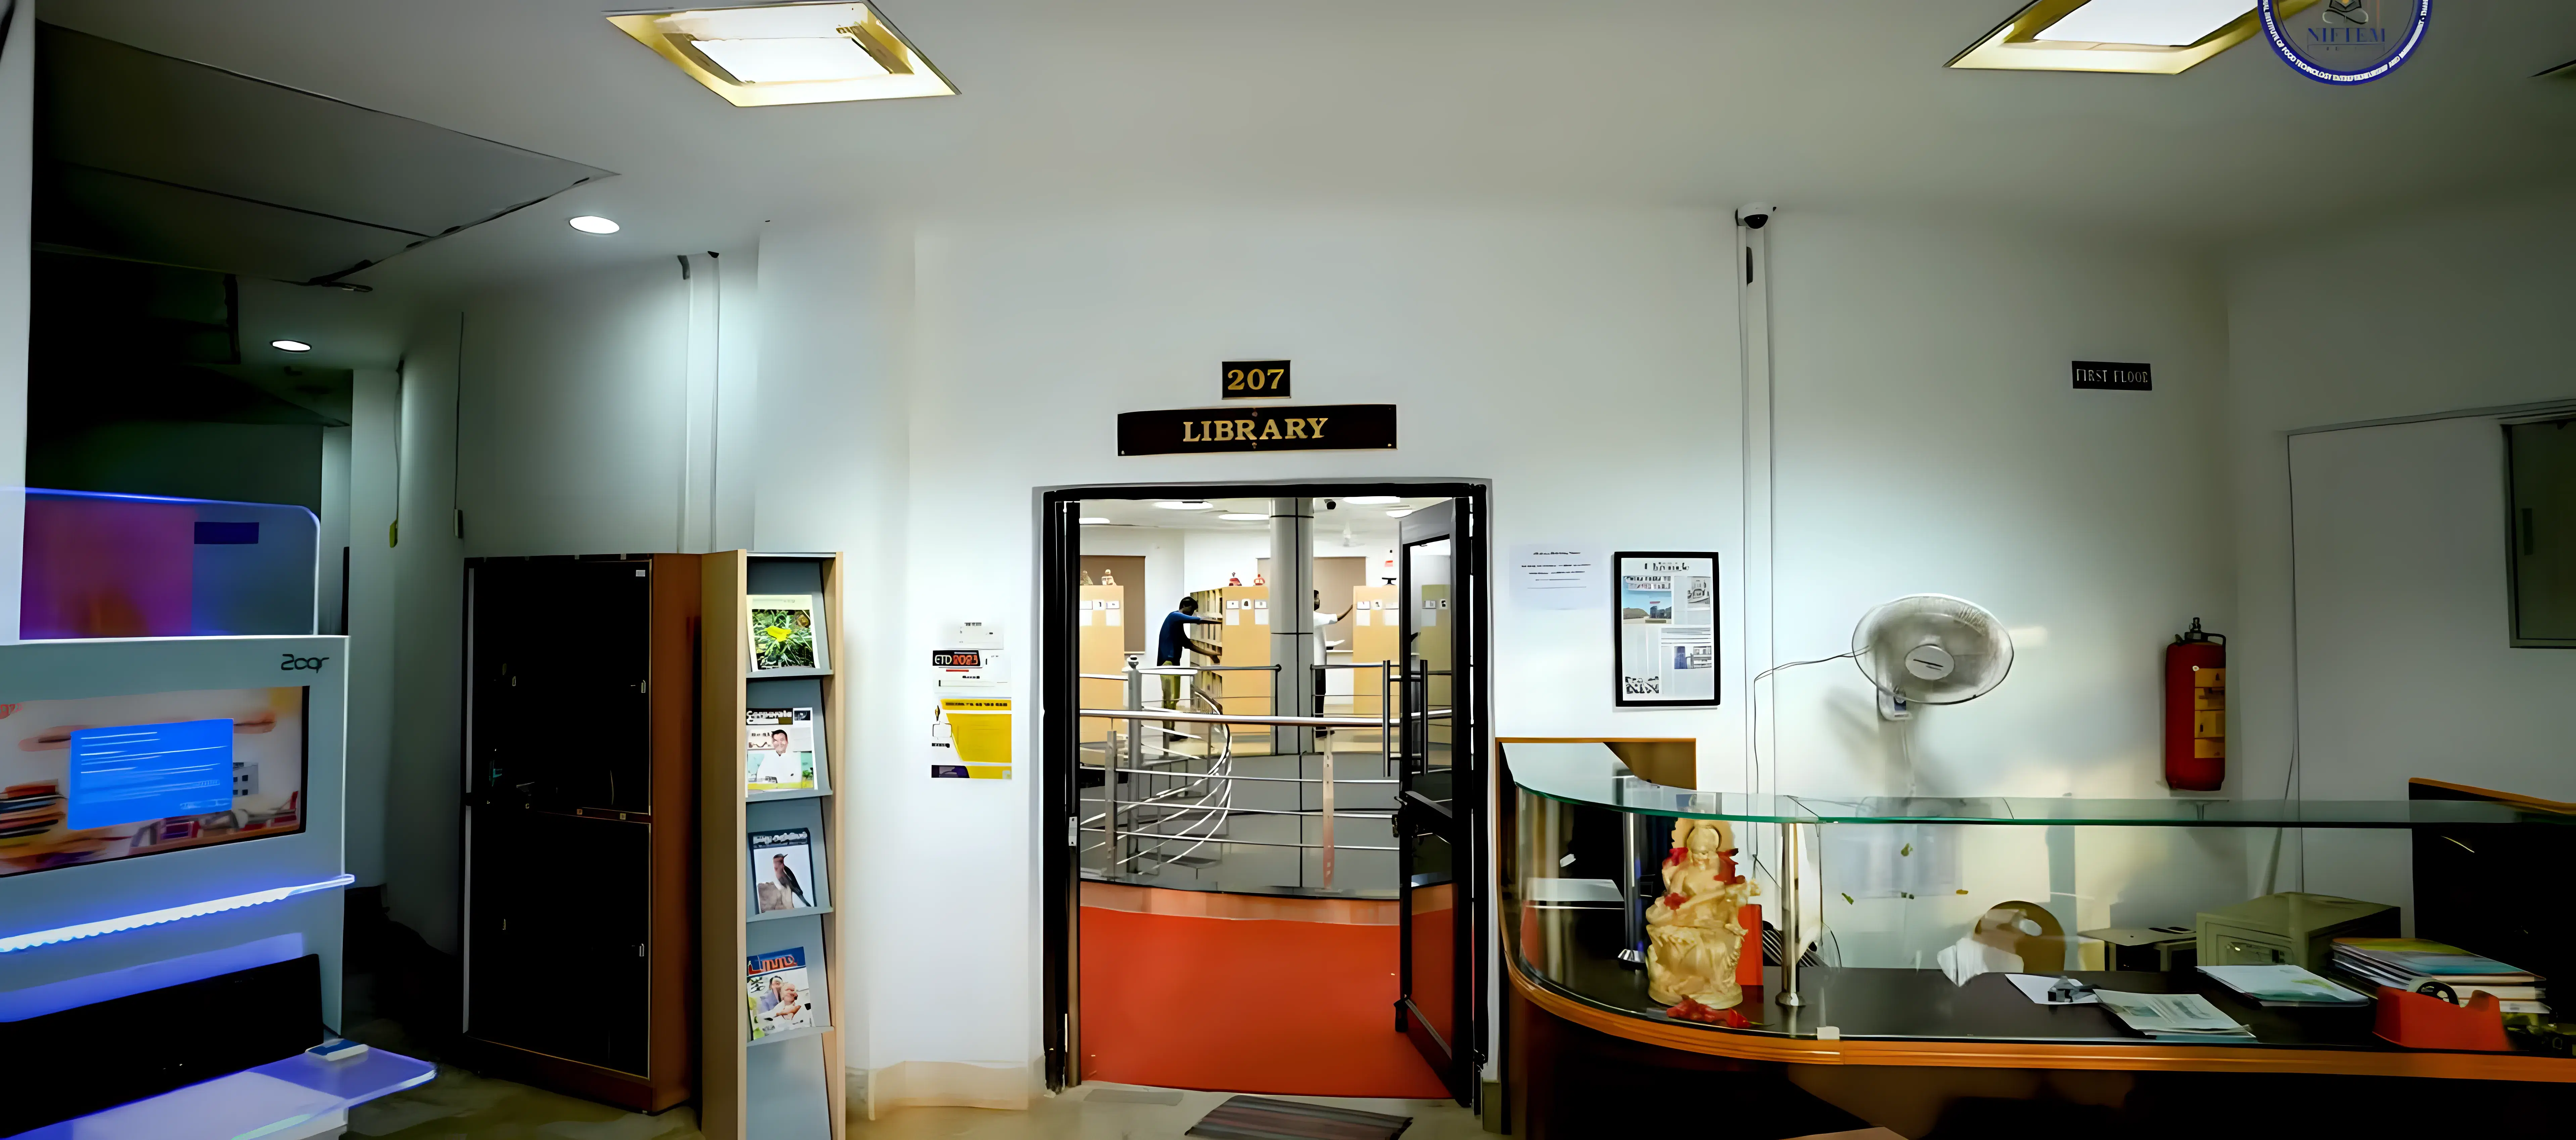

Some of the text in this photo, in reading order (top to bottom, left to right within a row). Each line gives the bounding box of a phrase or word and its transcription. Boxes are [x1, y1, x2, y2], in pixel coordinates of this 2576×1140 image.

[1227, 369, 1284, 390] 207
[2114, 370, 2148, 383] FLOOR
[1183, 418, 1329, 442] LIBRARY
